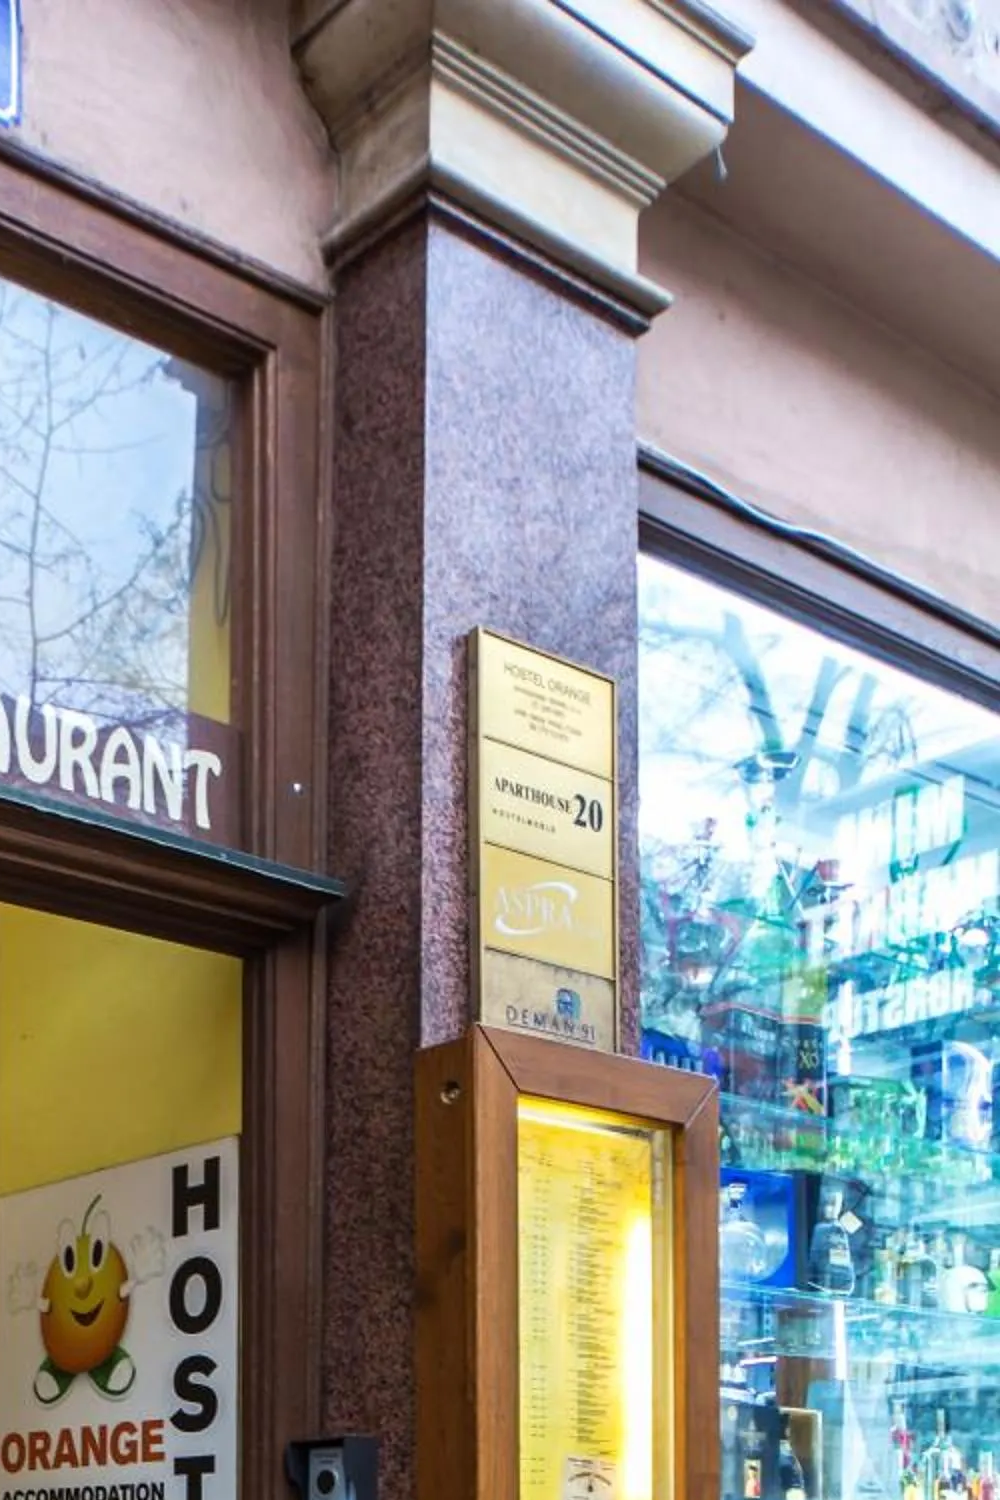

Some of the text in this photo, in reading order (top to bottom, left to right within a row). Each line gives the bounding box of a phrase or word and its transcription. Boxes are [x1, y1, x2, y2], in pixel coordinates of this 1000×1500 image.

[494, 776, 603, 833] APARTHOUSE 20
[1, 1418, 167, 1473] ORANGE
